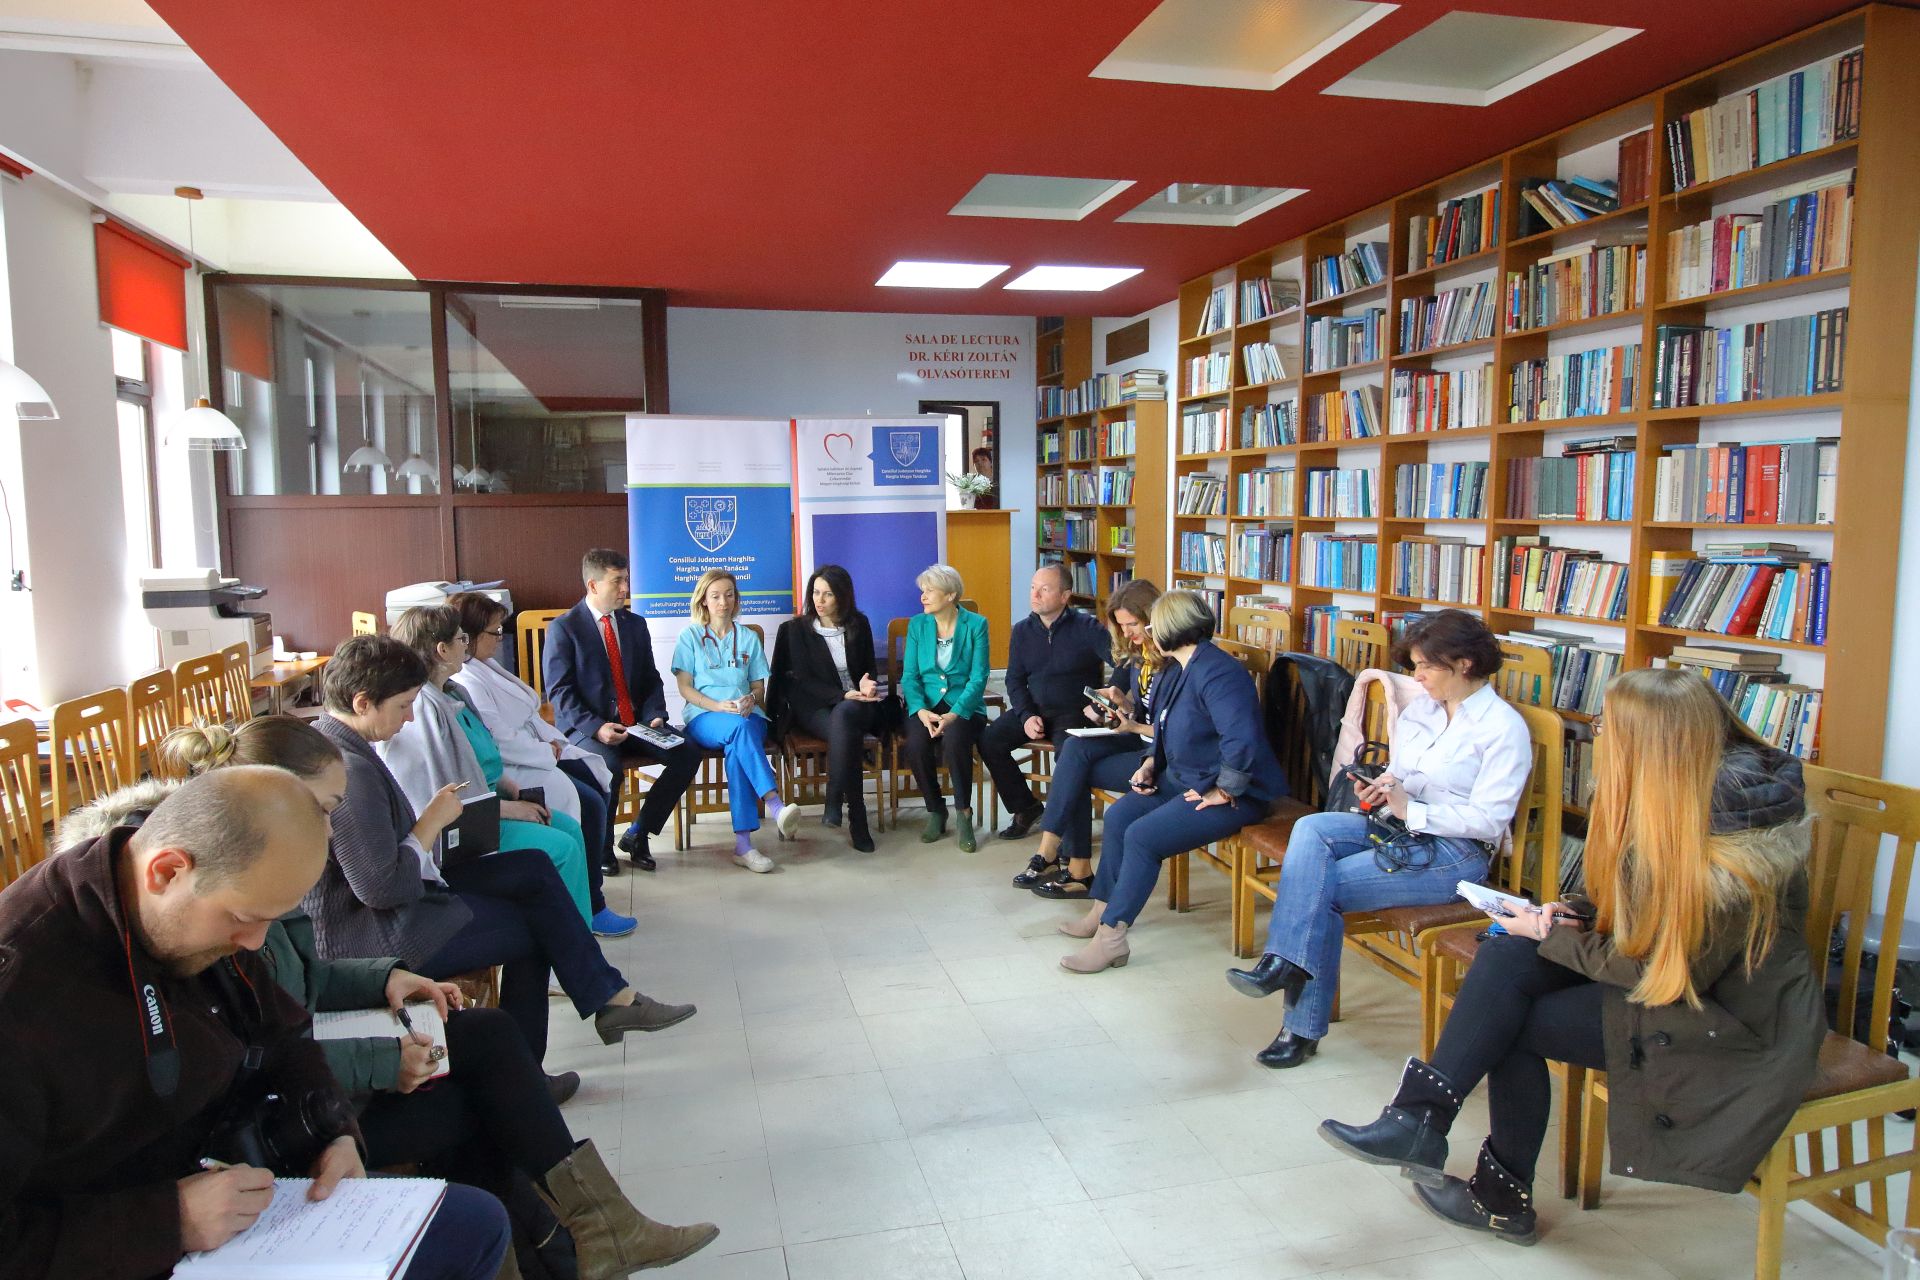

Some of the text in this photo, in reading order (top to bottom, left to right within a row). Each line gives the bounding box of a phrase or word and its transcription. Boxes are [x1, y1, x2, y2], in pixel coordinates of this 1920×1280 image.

[905, 333, 1020, 345] SALA DE LECTURA
[909, 348, 1017, 362] DR. KÉRI ZOLTÁN
[916, 366, 1011, 379] OLVASÓTEREM
[728, 555, 755, 563] Harghita
[676, 565, 700, 573] Hargita
[143, 984, 164, 1035] Canon
